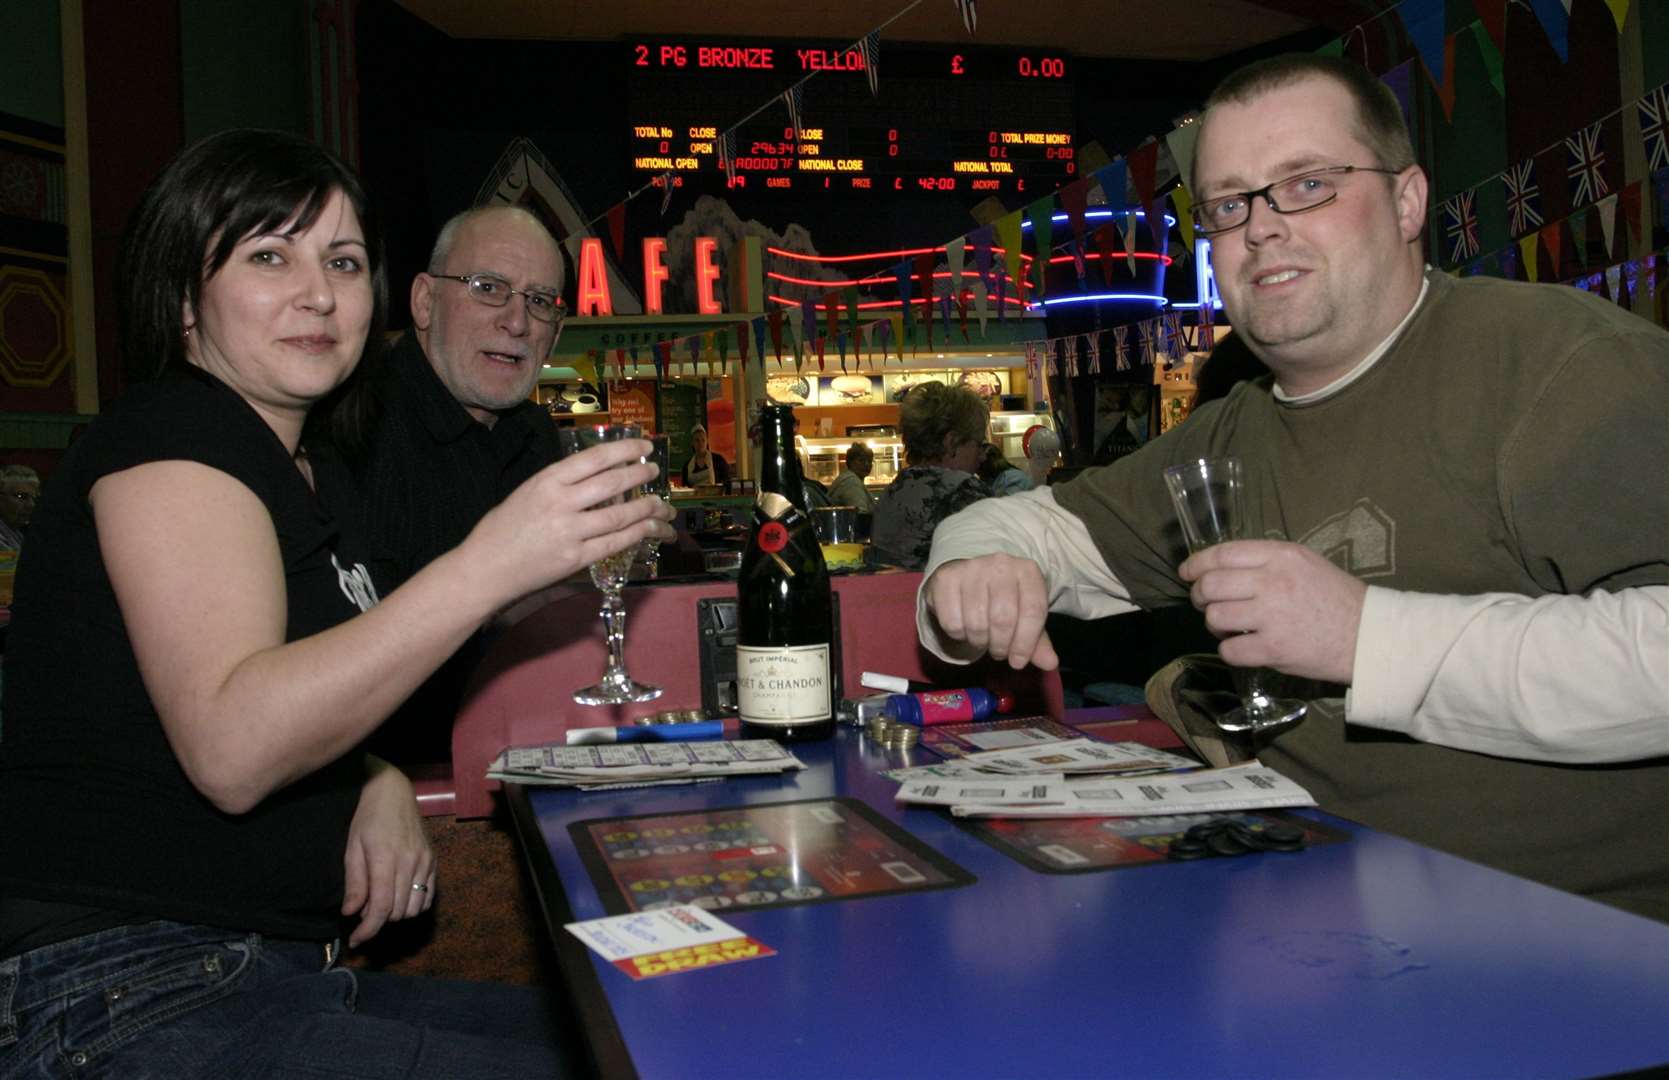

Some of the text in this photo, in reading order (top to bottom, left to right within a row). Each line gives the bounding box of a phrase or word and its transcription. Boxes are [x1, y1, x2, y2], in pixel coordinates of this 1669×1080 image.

[635, 45, 650, 66] 2
[660, 46, 688, 67] PG
[698, 47, 775, 69] BRONZE
[950, 54, 1065, 78] £ 0.00
[635, 126, 673, 138] TOTAL No
[689, 127, 716, 139] CLOSE
[1001, 132, 1071, 145] TOTAL PRIZE MONEY
[690, 143, 713, 154] OPEN
[635, 158, 698, 170] NATIONAL OPEN
[798, 159, 863, 171] NATIONAL CLOSE
[953, 161, 1013, 173] NATIONAL TOTAL
[767, 177, 791, 188] GAMES
[852, 178, 871, 188] PRIZE
[972, 179, 1000, 190] JACKPOT
[577, 236, 722, 317] AFE
[758, 680, 766, 689] &
[768, 676, 823, 690] CHANDON
[637, 944, 762, 977] DRAW
